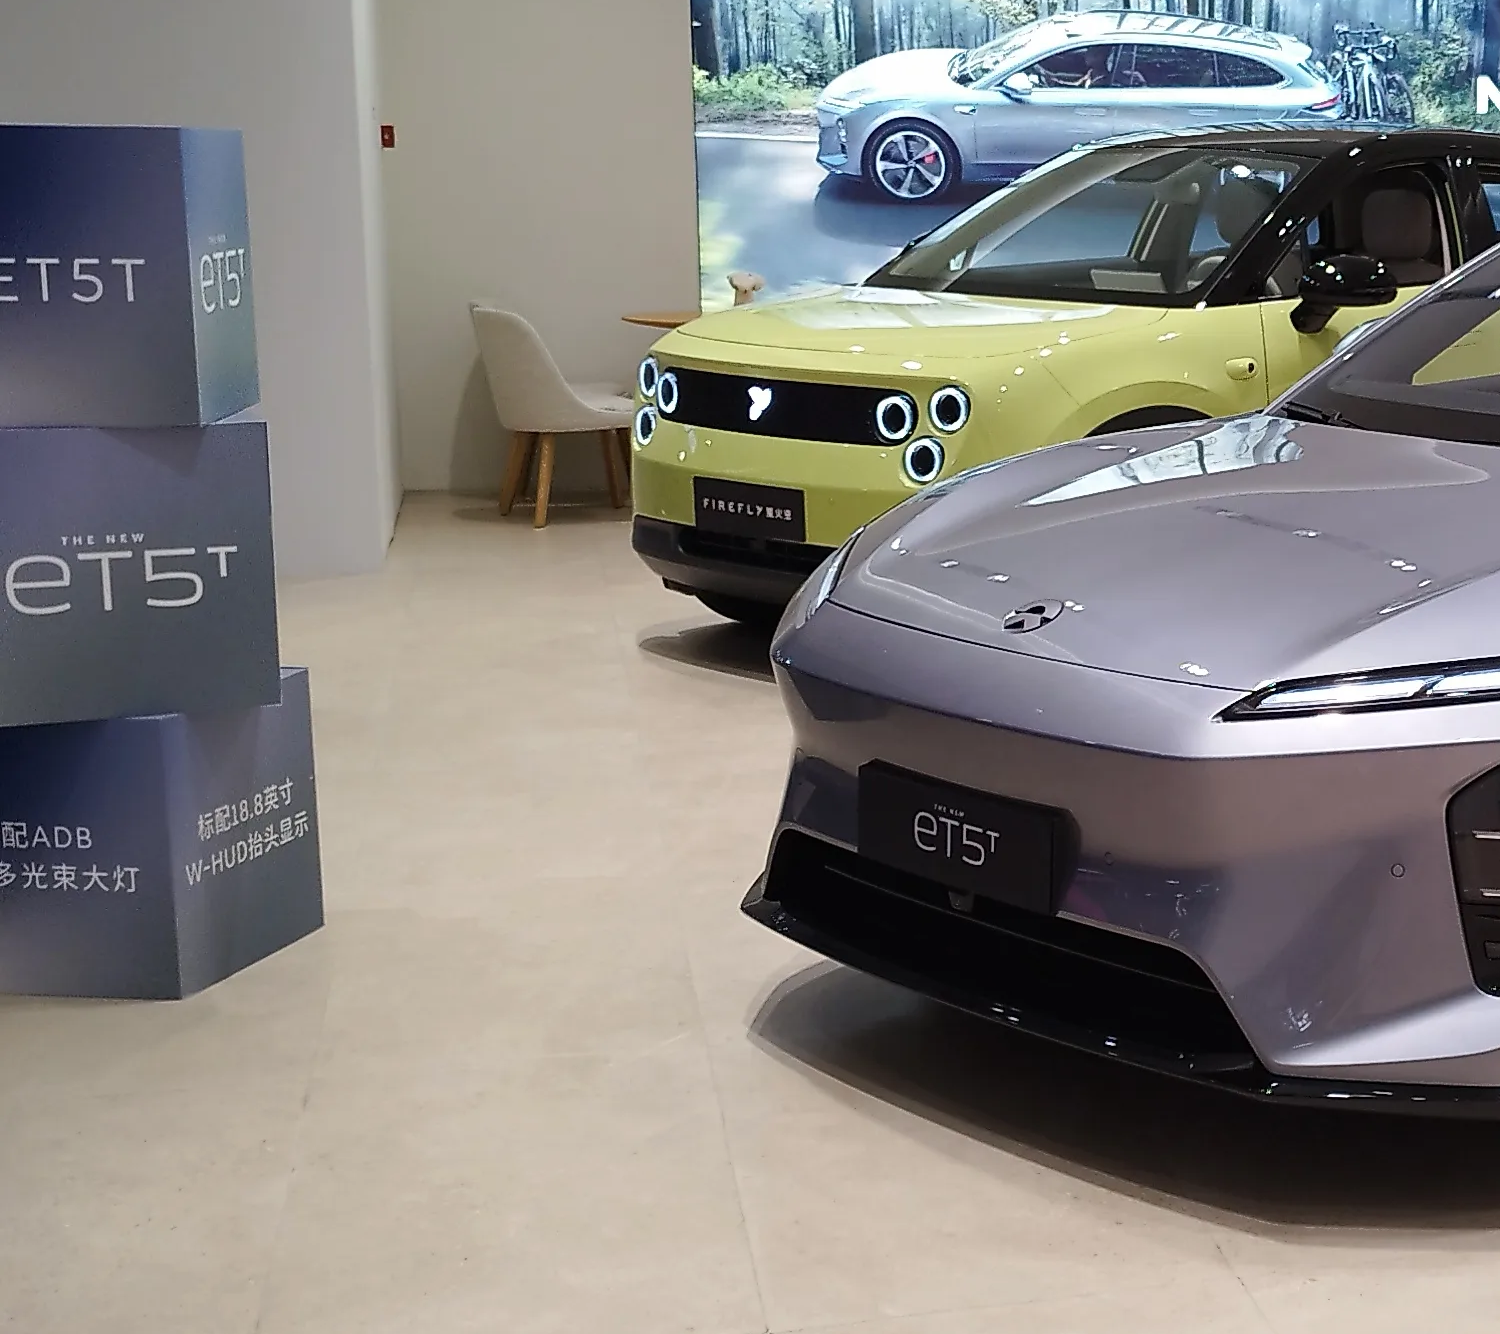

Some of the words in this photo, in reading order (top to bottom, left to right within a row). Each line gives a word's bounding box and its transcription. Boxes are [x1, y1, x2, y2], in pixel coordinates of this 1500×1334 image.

[702, 497, 764, 517] FIREFLY
[61, 534, 95, 546] THE
[106, 532, 145, 545] NEW
[197, 776, 294, 843] 标配18.8英寸
[185, 810, 309, 886] W-HUD抬头显示
